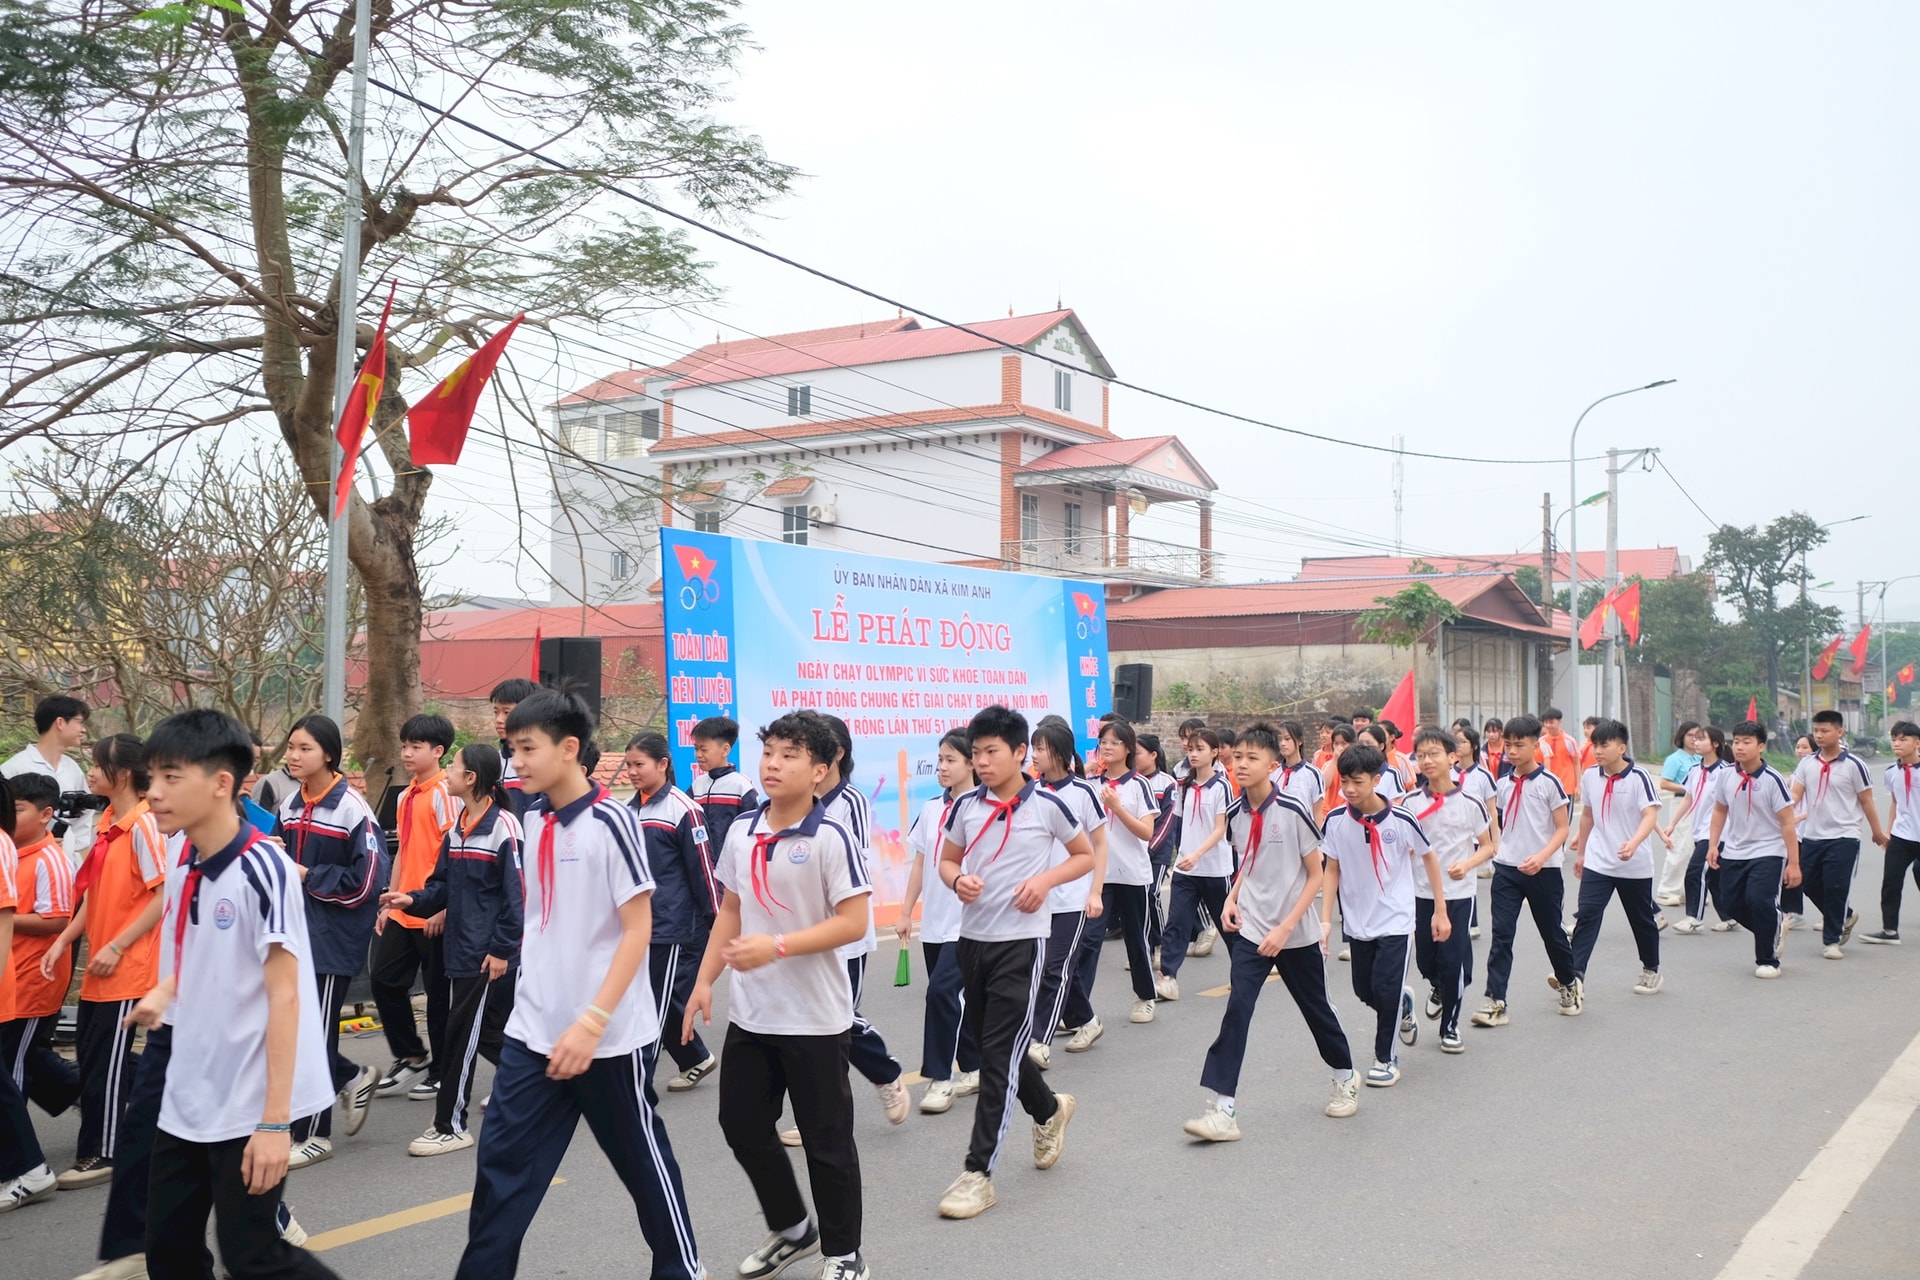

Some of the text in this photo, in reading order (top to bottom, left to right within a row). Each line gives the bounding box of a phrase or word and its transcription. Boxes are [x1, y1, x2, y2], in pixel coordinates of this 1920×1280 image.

[834, 563, 992, 600] ỦY BAN NHÂN DÂN XÃ KIM ANH
[812, 593, 1012, 657] LỄ PHÁT ĐỘNG
[672, 628, 729, 663] TOÀN DÂN
[797, 659, 1027, 685] NGÀY CHẠY OLYMPIC VÌ SỨC KHỎE TOÀN DÂN
[671, 670, 733, 710] RÈN LUYỆN
[771, 686, 788, 708] VÀ
[791, 687, 823, 708] PHÁT
[826, 688, 857, 711] ĐỘNG
[860, 691, 898, 708] CHUNG
[901, 687, 920, 708] KẾT
[923, 687, 944, 708] GIẢI
[947, 694, 973, 712] CHẠY
[1012, 692, 1028, 712] NỘI
[1031, 691, 1048, 709] MỚI
[854, 715, 885, 738] RỘNG
[888, 712, 909, 735] LẦN
[912, 714, 932, 734] THỨ
[934, 719, 946, 734] 51
[916, 759, 933, 776] Kim
